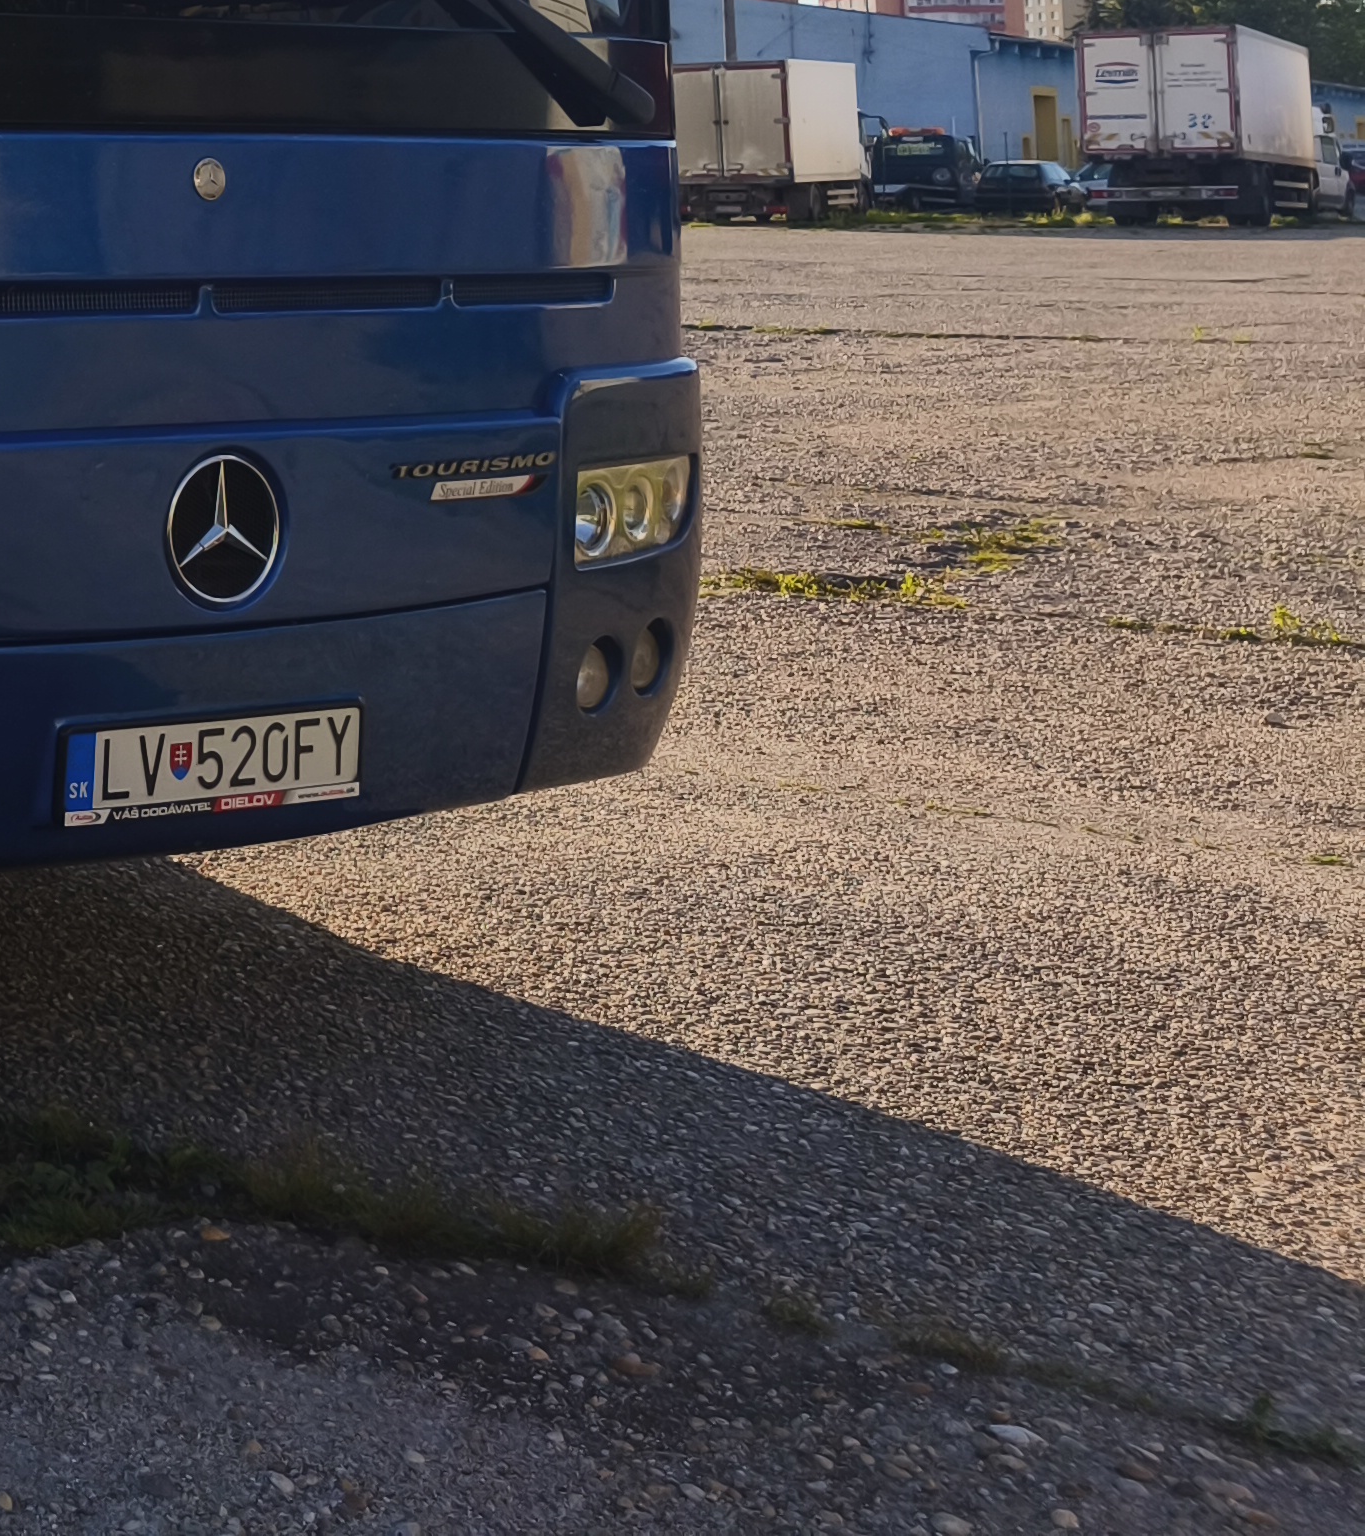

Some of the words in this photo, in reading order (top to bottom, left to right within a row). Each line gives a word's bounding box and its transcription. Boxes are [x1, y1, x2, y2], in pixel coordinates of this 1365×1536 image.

[393, 450, 557, 479] TOURISMO
[439, 480, 477, 498] Special
[478, 479, 514, 495] Edition
[101, 732, 166, 801] LV
[196, 714, 352, 790] 520FY
[68, 781, 89, 799] SK
[112, 807, 140, 820] VÁŠ
[220, 793, 276, 810] DIELOV
